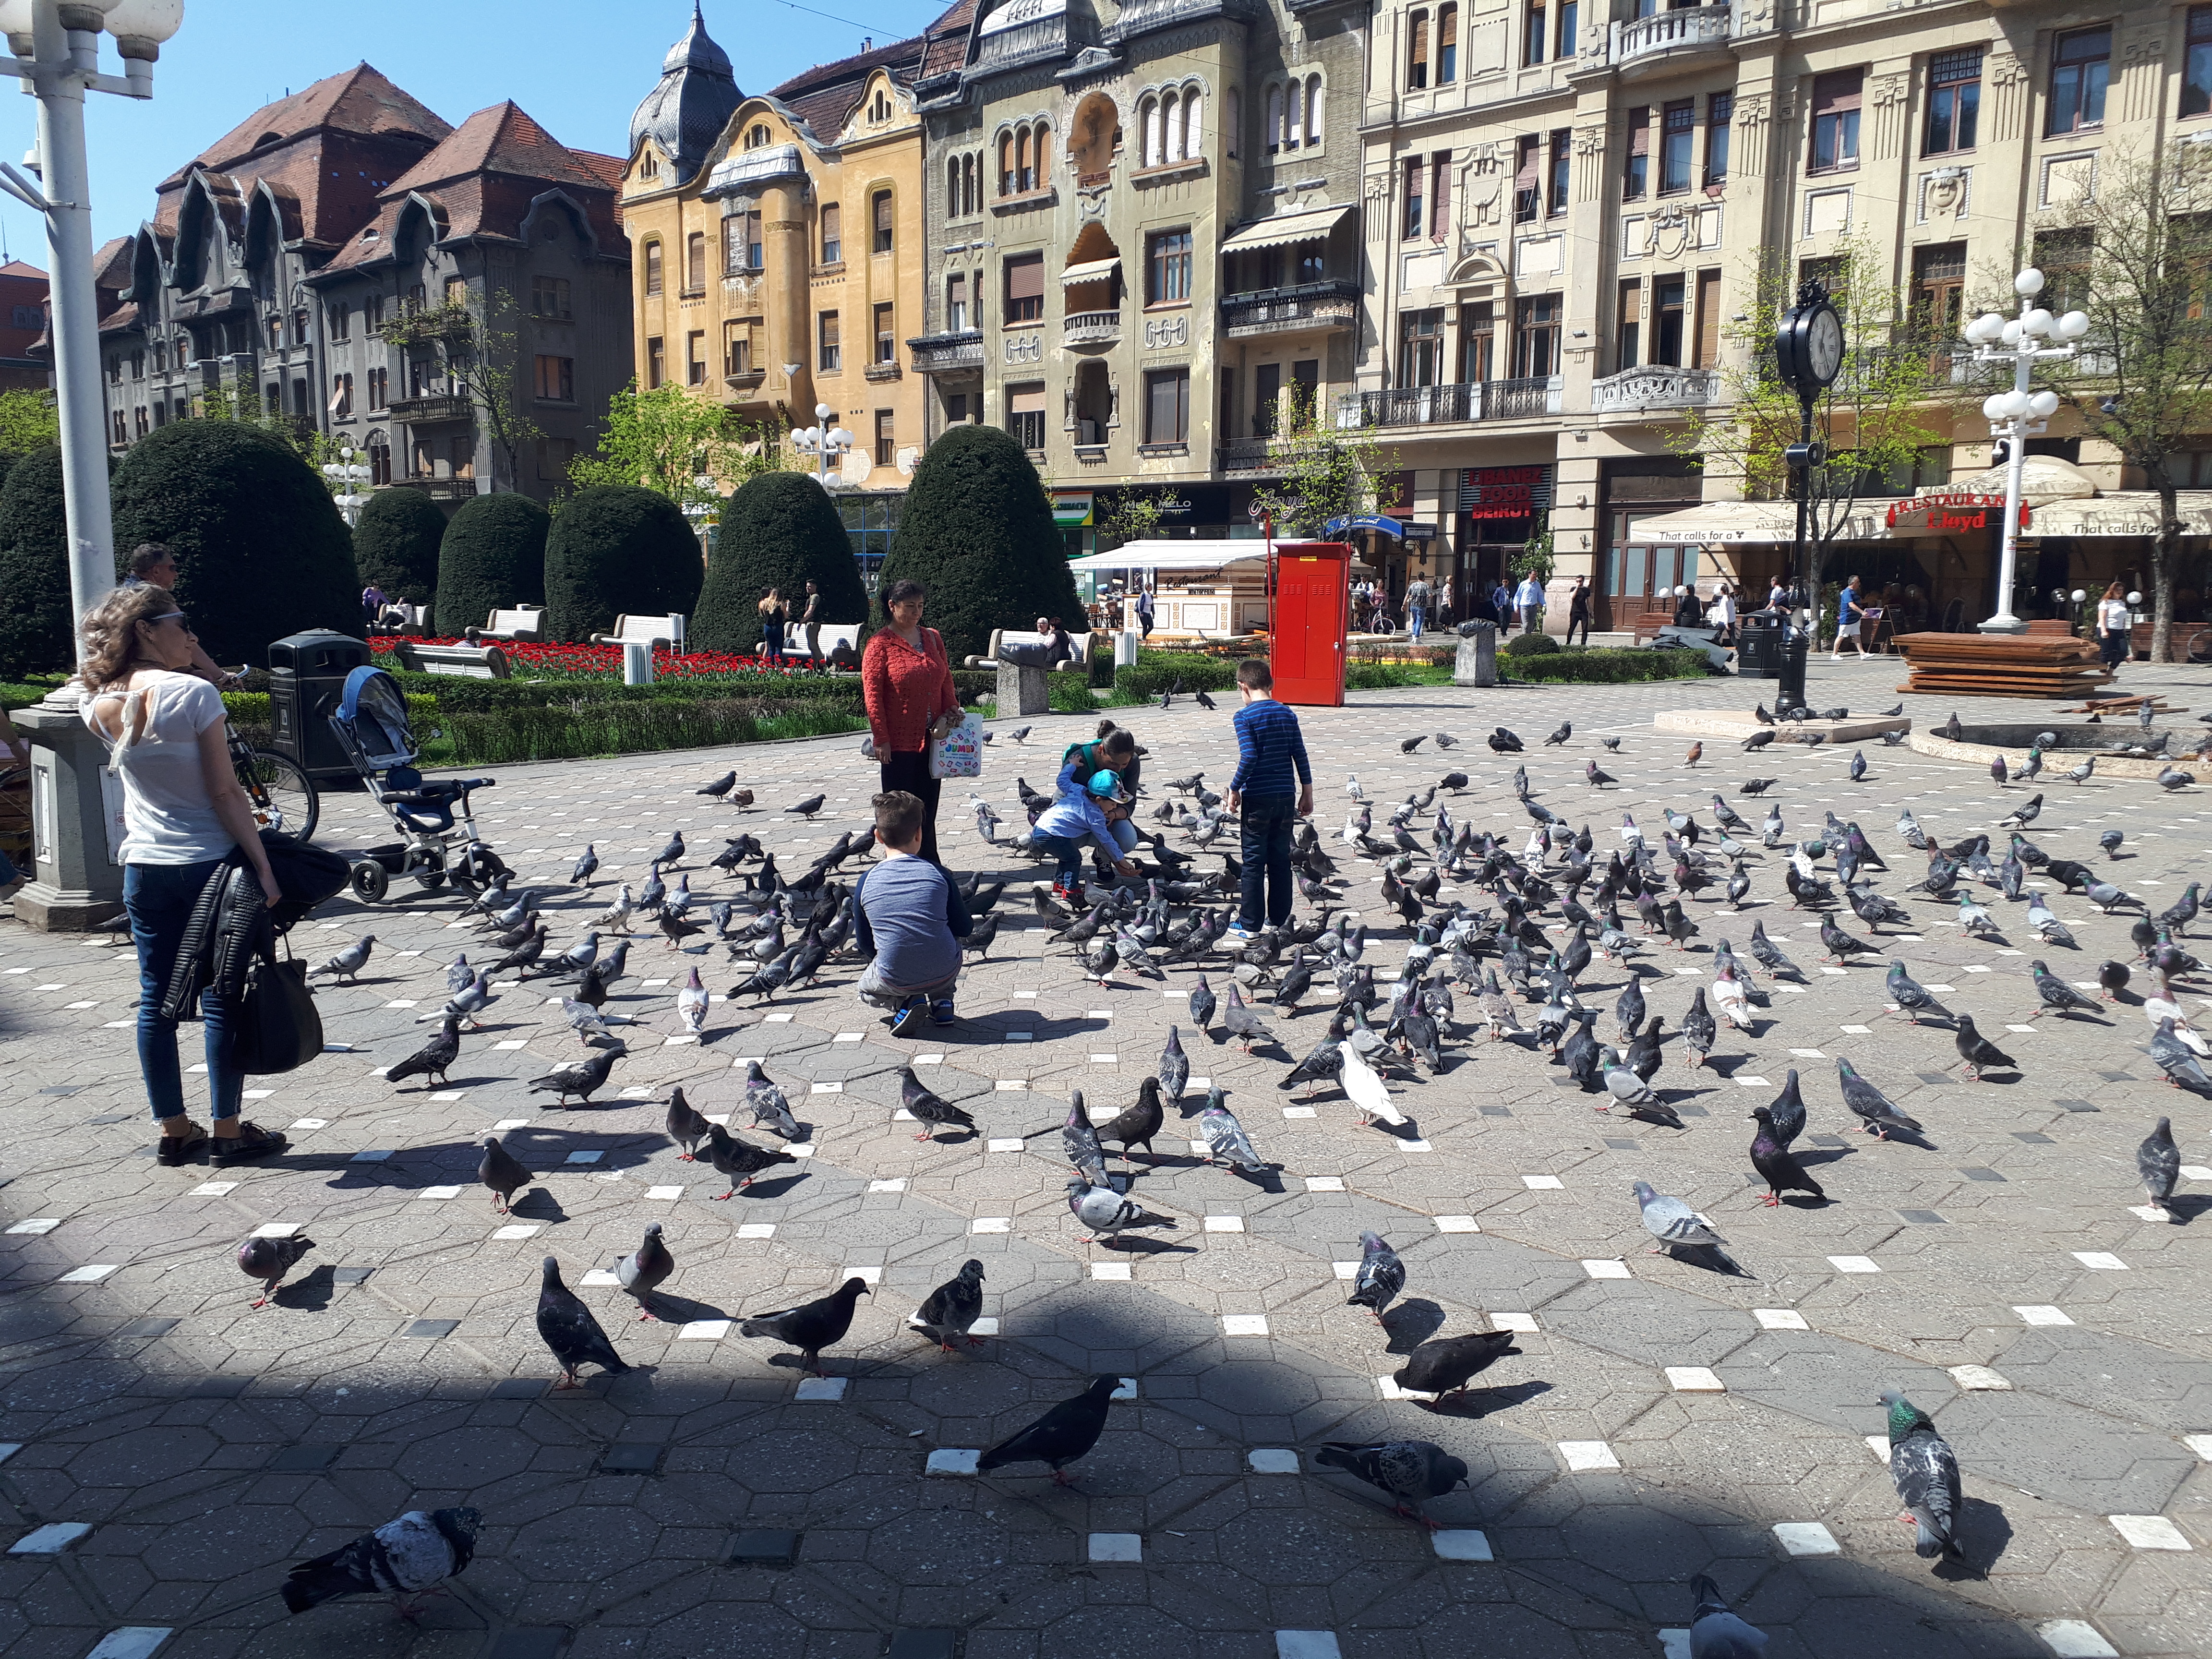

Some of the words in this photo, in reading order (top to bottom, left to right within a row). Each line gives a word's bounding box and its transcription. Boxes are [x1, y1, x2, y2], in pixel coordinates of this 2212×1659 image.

[1469, 467, 1543, 486] LIBANEZ
[1480, 485, 1531, 503] FOOD
[1898, 493, 2007, 513] RESTAURAN
[1472, 501, 1534, 519] BEIRUT
[1927, 511, 1986, 533] Lloyd
[2072, 523, 2102, 534] That
[2107, 523, 2137, 533] calls
[2141, 522, 2161, 533] for
[1659, 531, 1681, 541] That
[1684, 531, 1706, 540] calls
[1709, 530, 1723, 540] for
[1164, 567, 1224, 592] Restaurant
